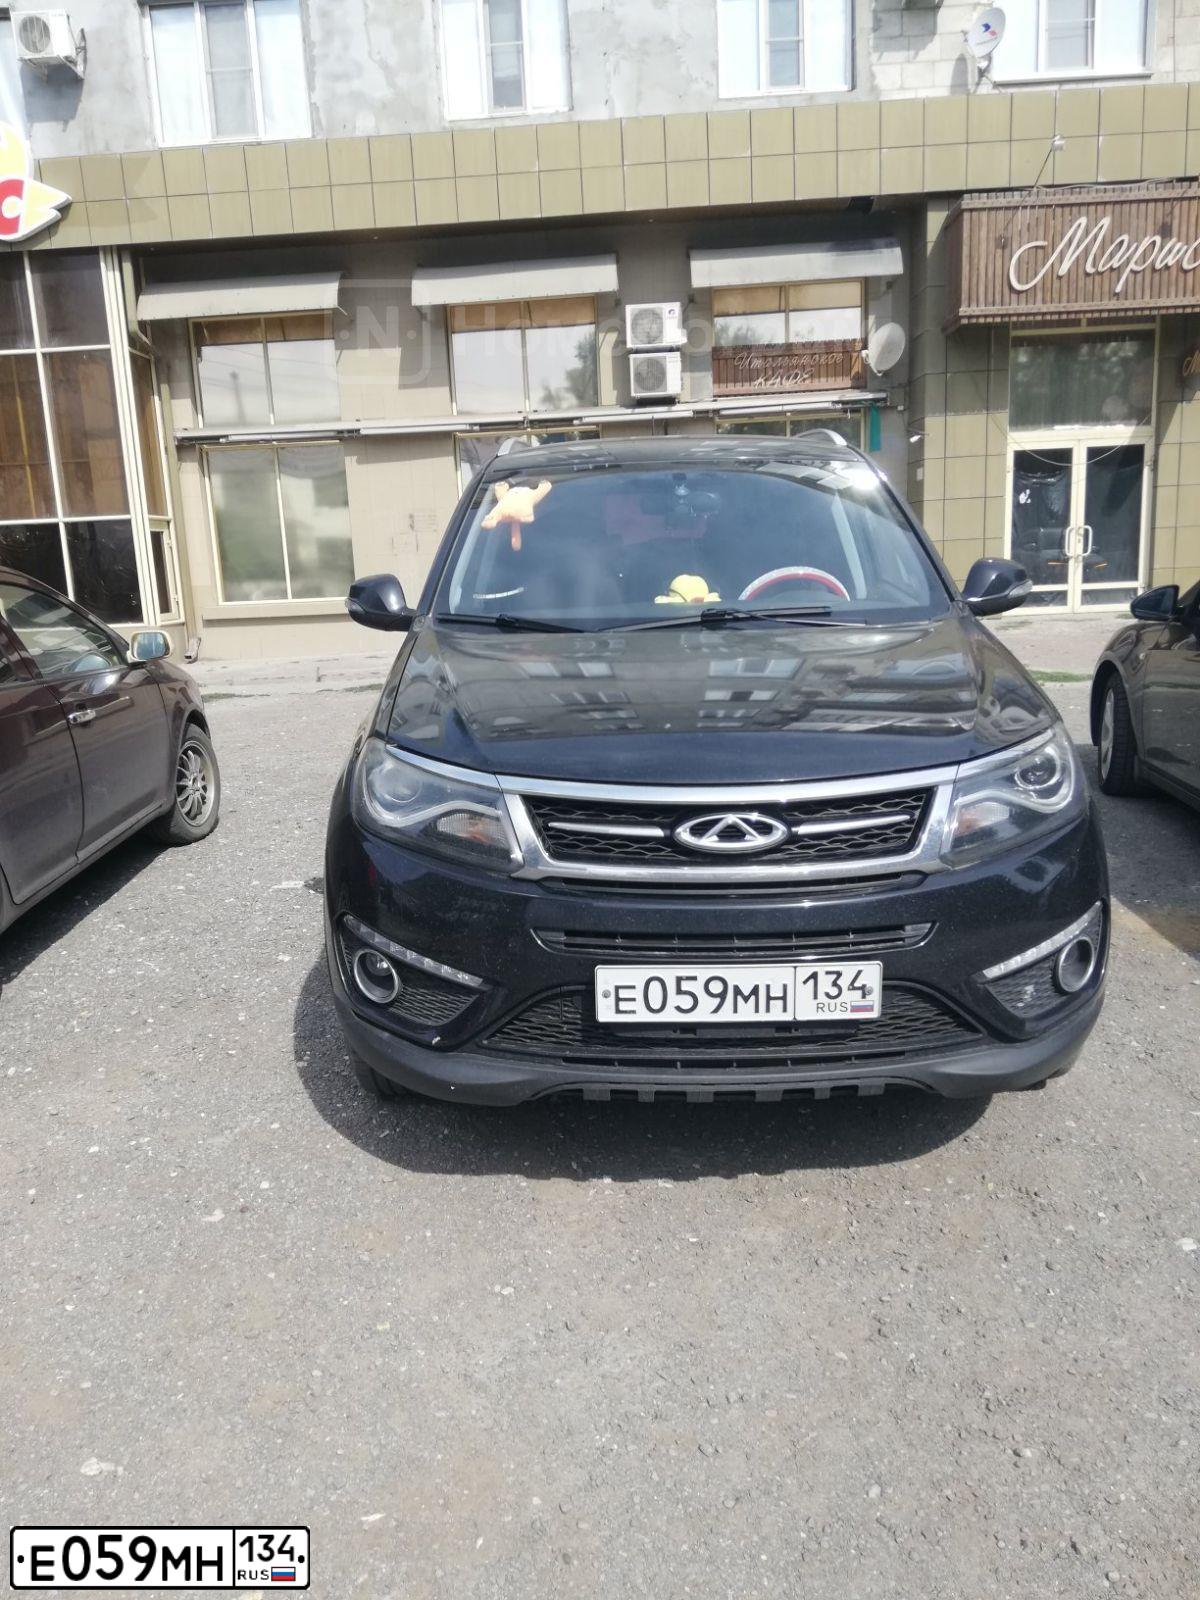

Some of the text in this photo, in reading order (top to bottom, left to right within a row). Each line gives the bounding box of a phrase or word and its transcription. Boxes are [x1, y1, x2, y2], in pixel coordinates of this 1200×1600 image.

[613, 969, 868, 1015] Е059МН 134
[816, 1001, 848, 1014] RUS
